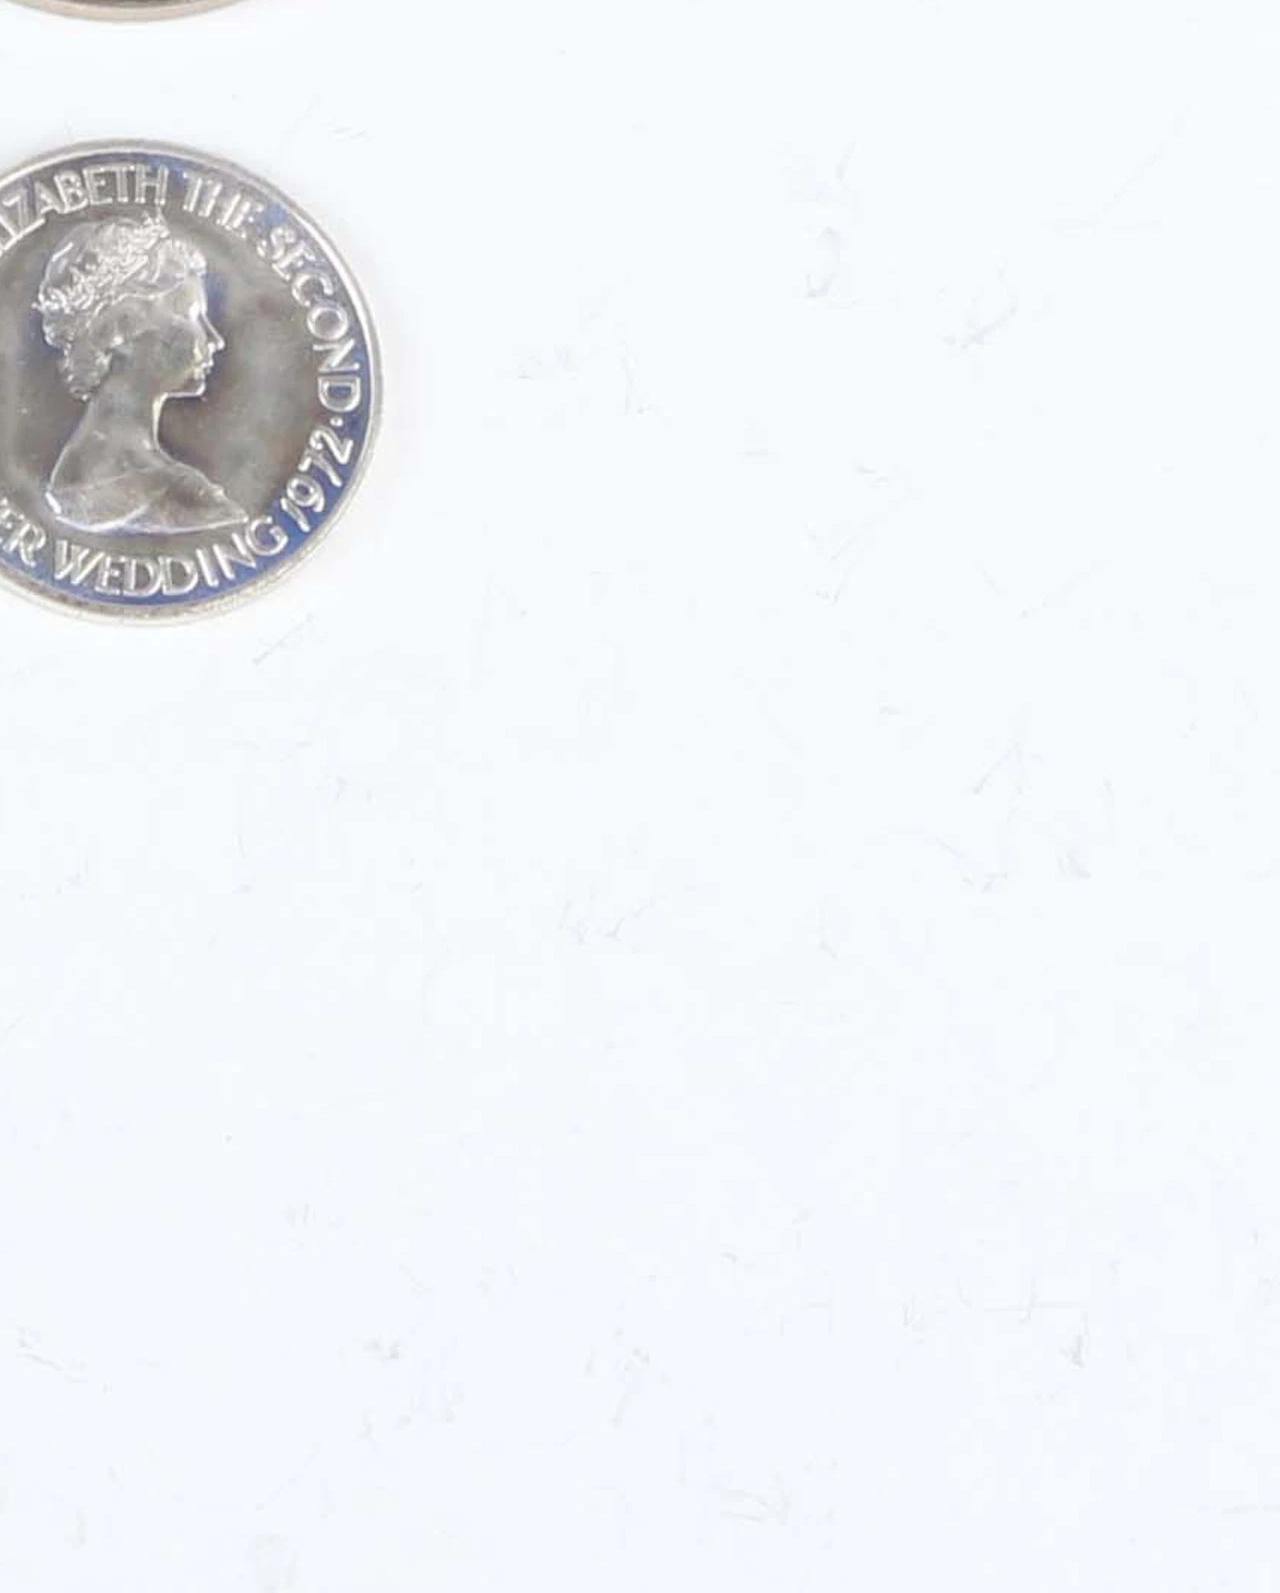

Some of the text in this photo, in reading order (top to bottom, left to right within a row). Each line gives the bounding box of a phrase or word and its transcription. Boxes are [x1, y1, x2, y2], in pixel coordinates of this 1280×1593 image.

[180, 170, 265, 239] THE
[255, 225, 365, 415] SECOND
[50, 512, 291, 600] WEDDING
[278, 425, 357, 536] 1972
